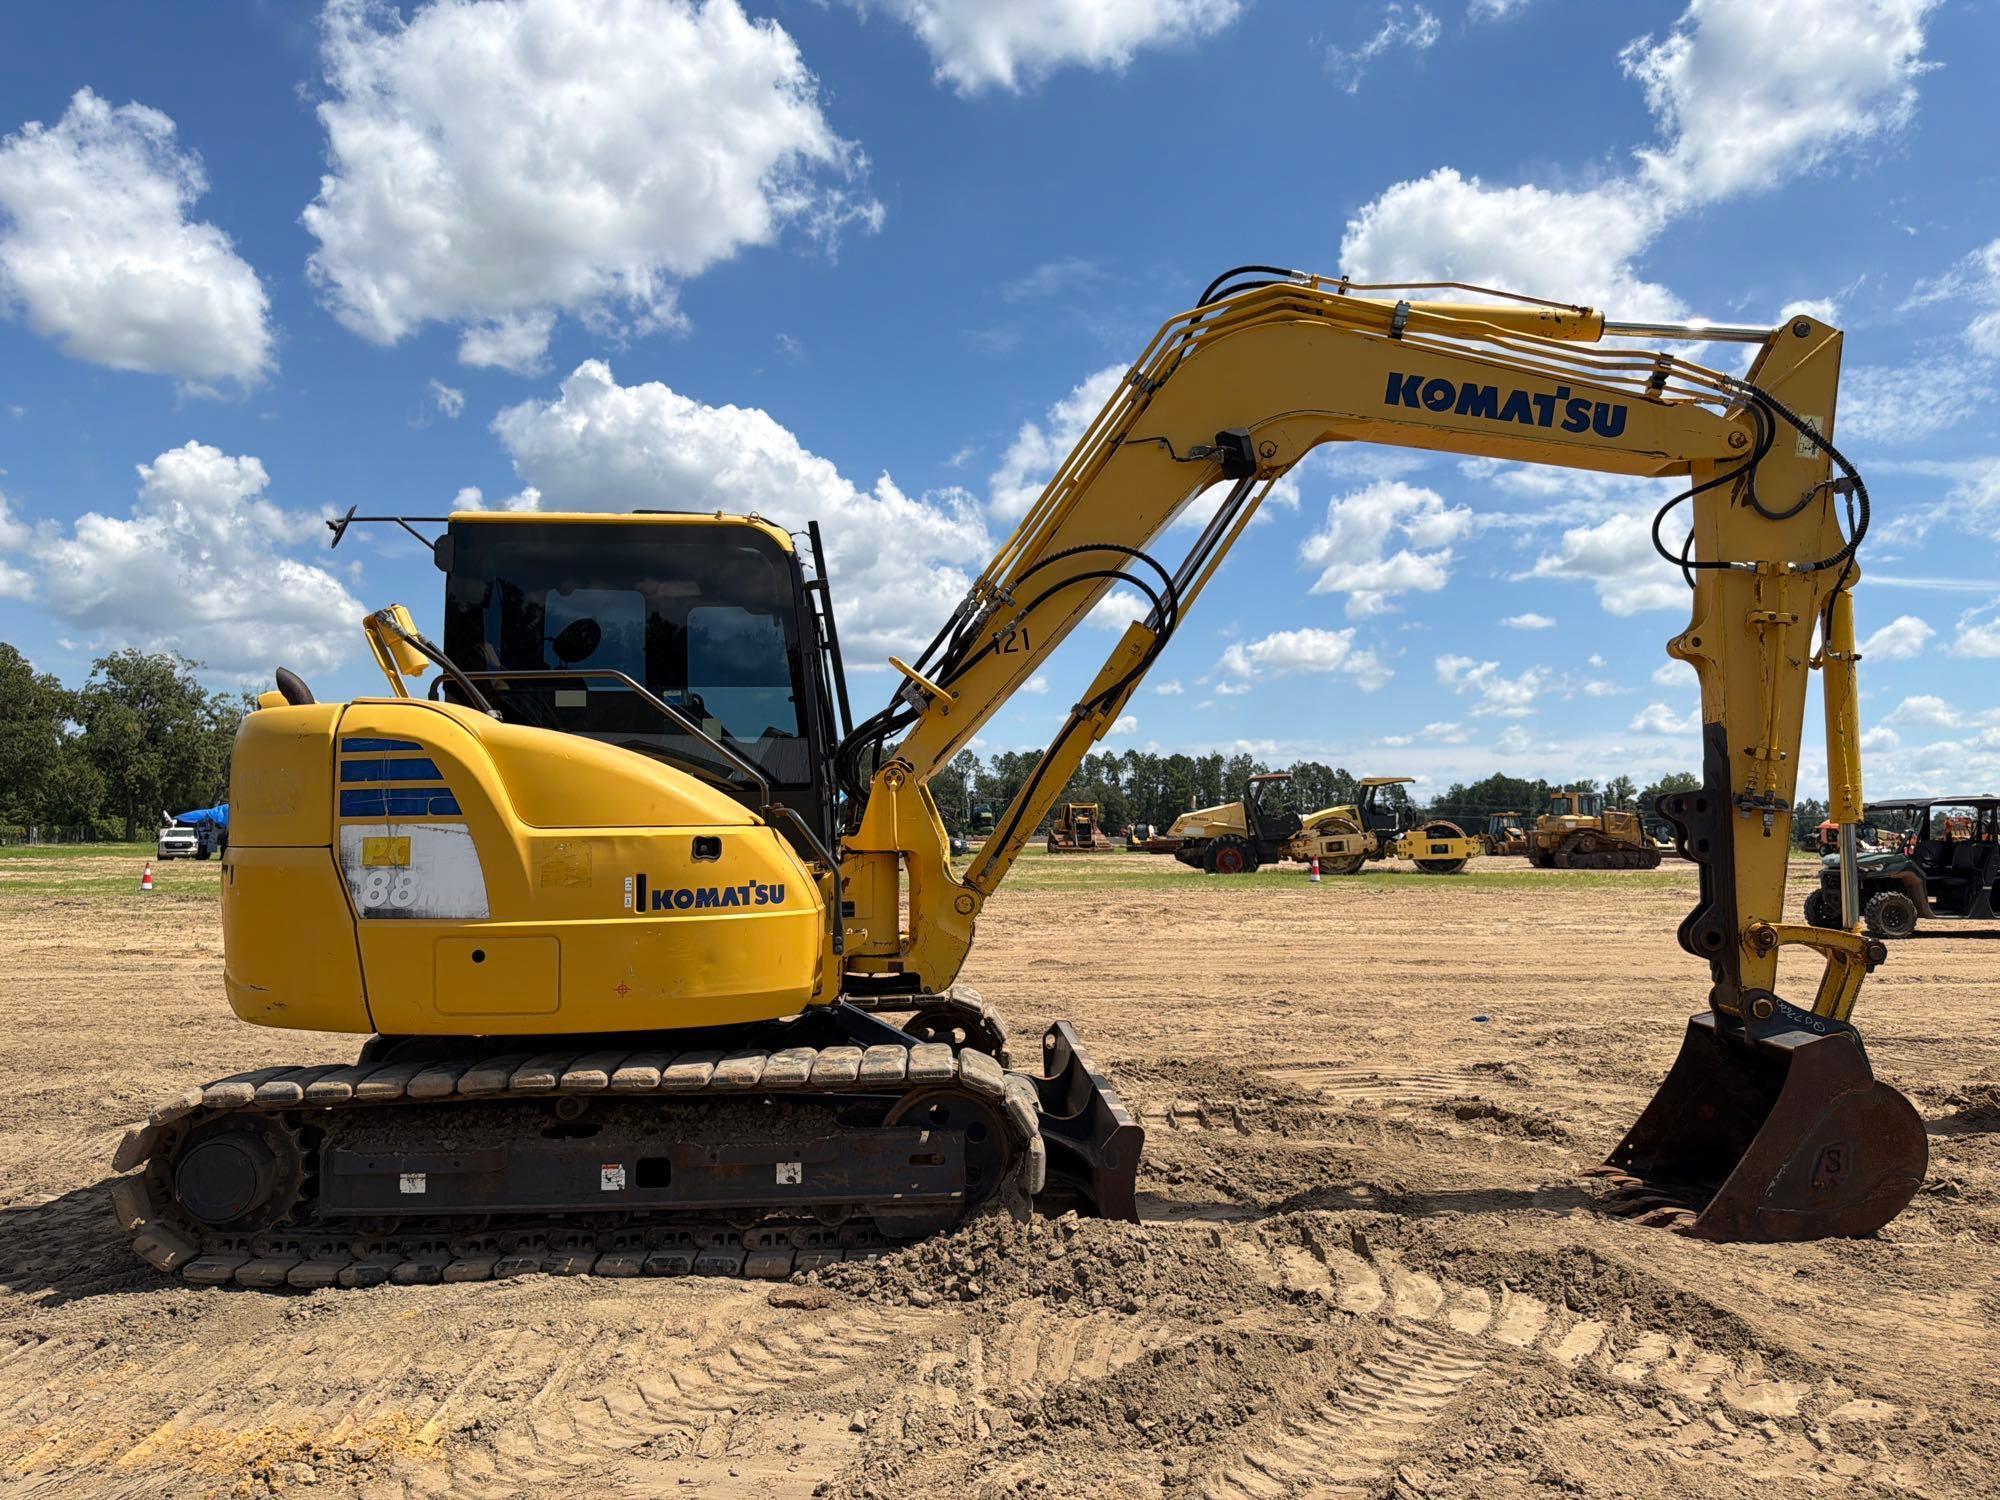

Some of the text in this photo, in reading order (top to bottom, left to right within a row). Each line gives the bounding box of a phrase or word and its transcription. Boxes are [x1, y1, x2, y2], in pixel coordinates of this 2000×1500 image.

[1384, 371, 1628, 438] KOMATSU
[992, 627, 1030, 655] 121
[364, 837, 409, 865] PC
[651, 879, 785, 911] KOMATSU
